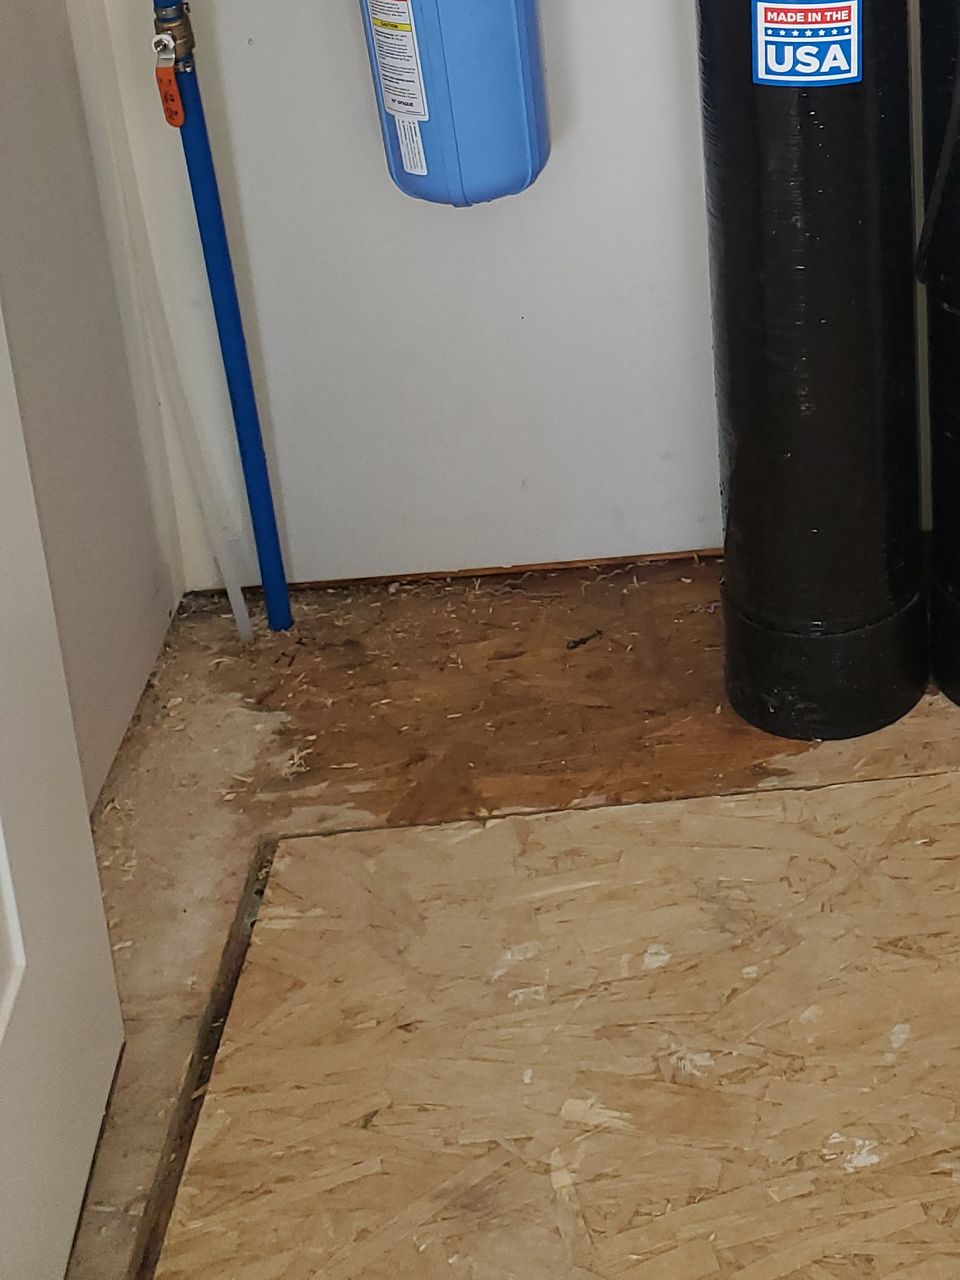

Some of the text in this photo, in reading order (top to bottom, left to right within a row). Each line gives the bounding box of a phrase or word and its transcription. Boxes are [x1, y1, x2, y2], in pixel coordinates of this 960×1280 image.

[767, 10, 849, 22] MADE IN THE
[380, 20, 399, 29] CAUTION
[766, 43, 850, 74] USA
